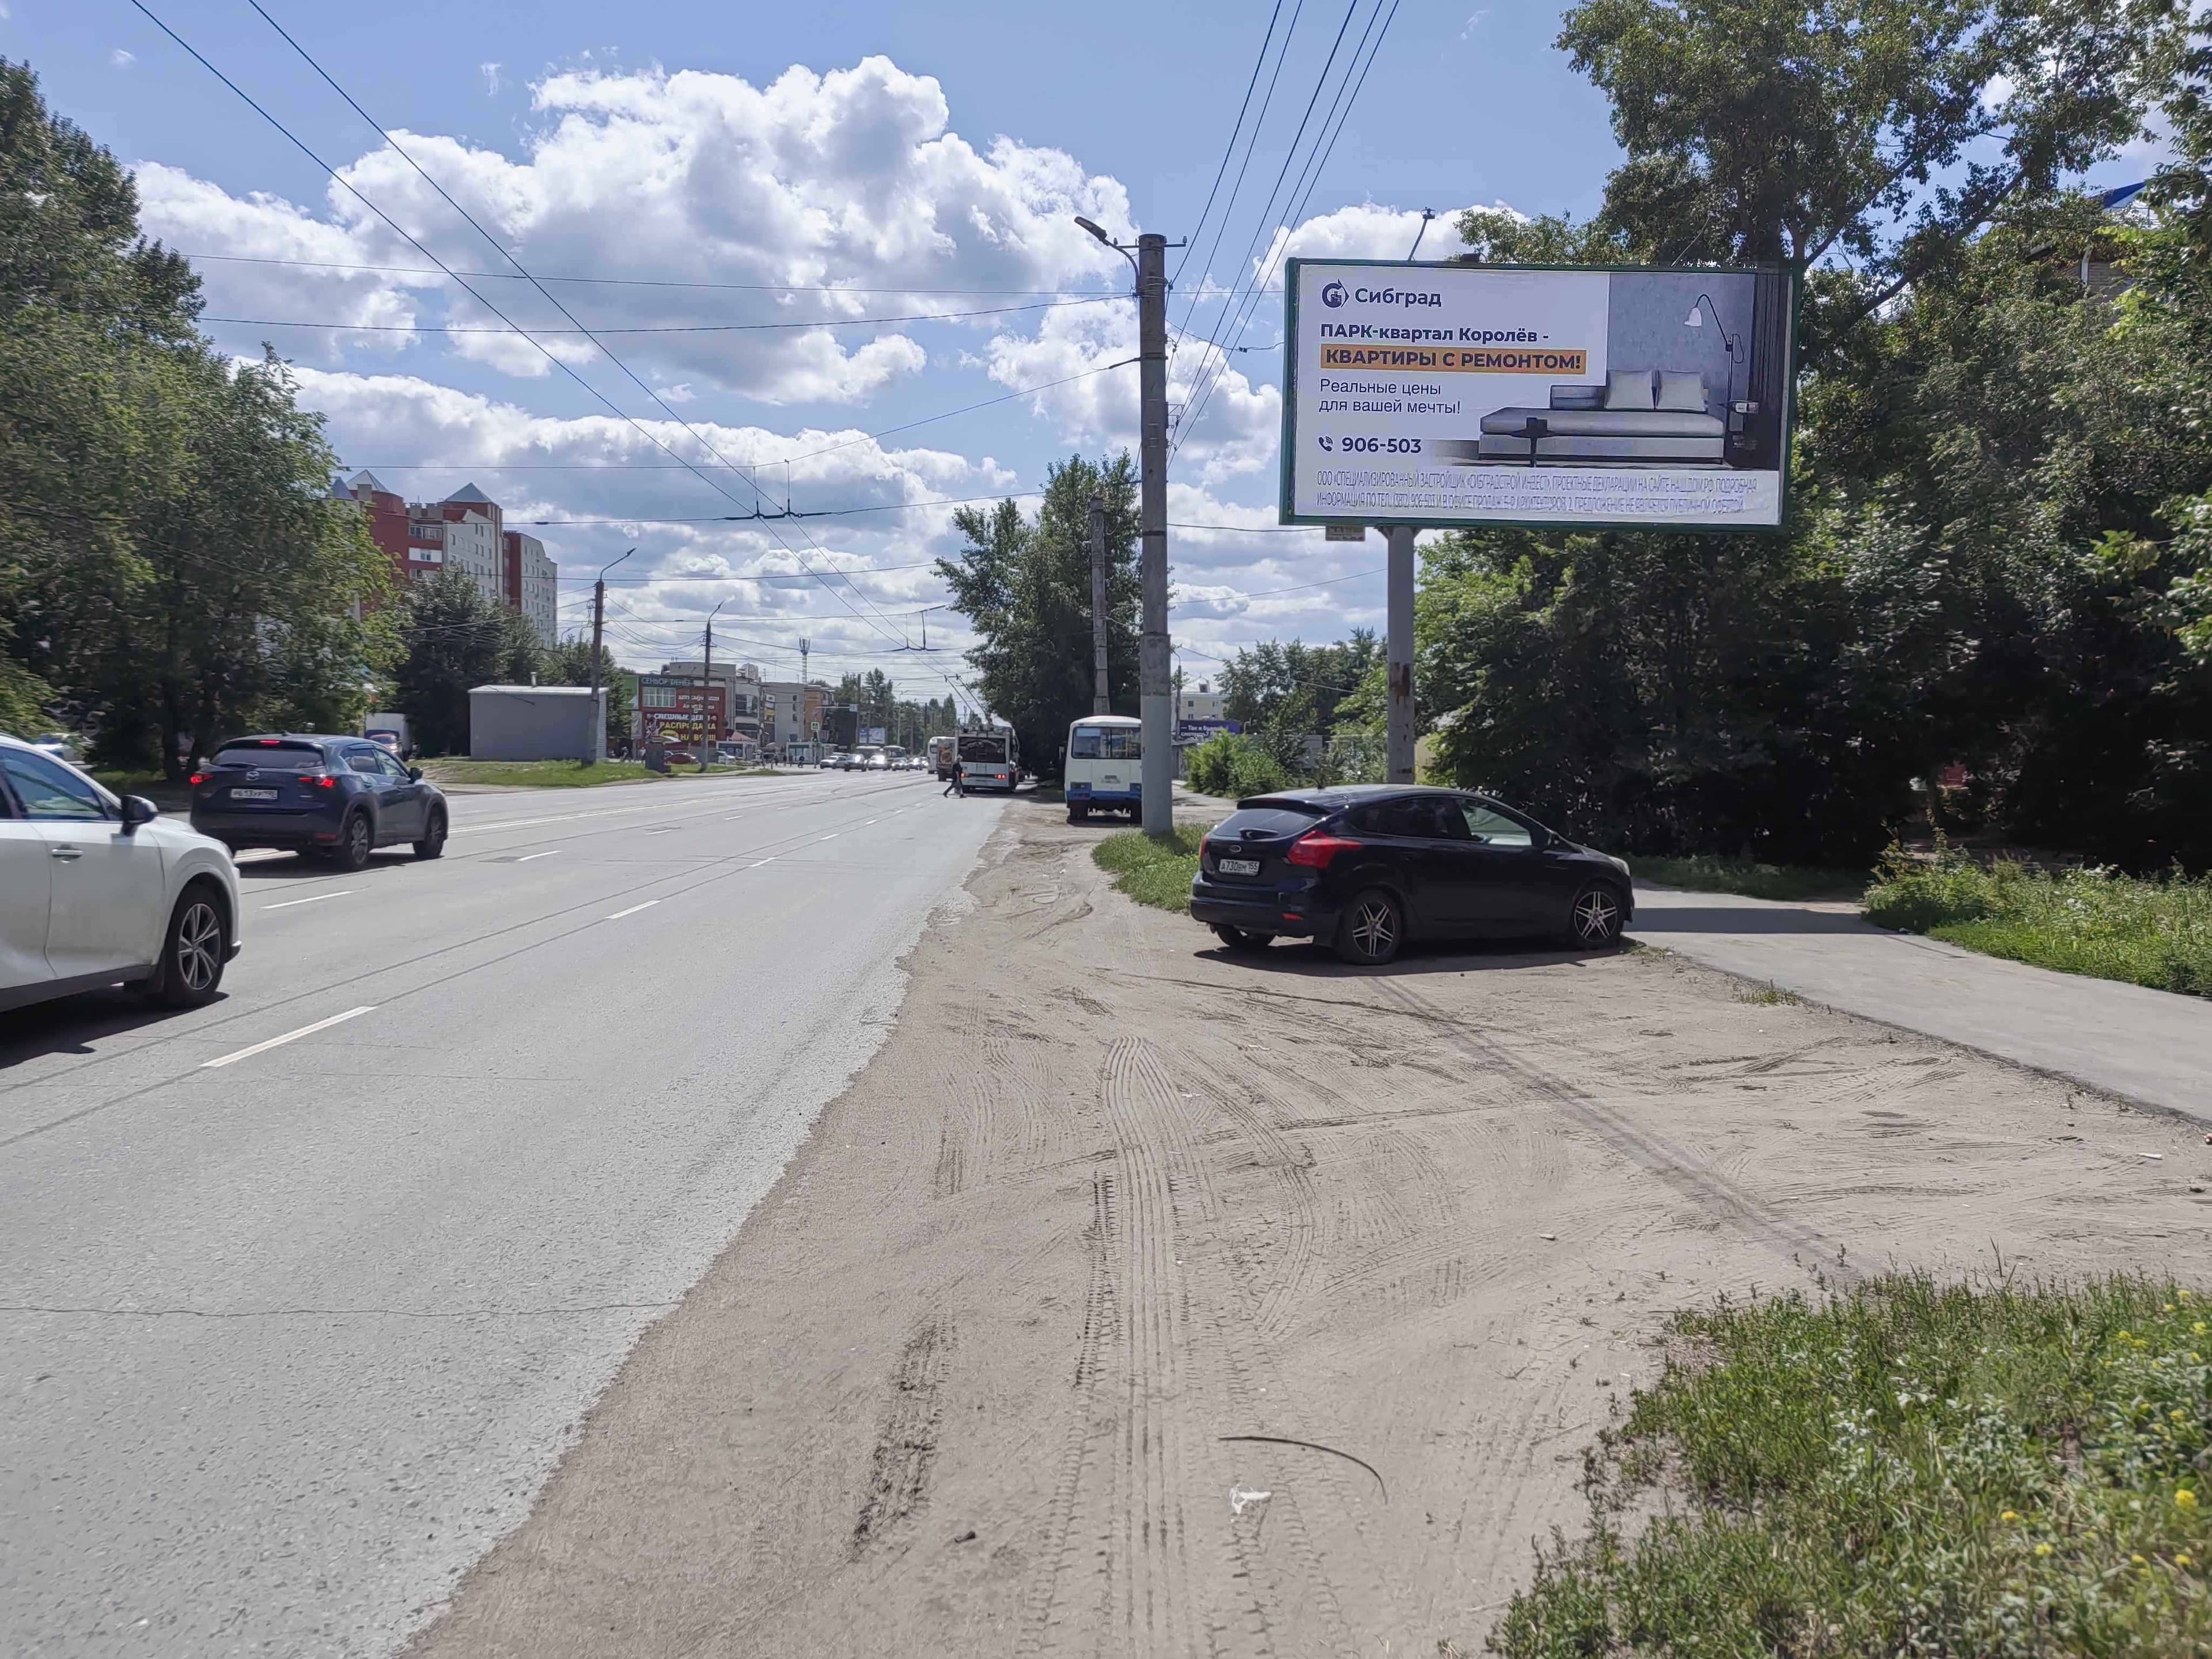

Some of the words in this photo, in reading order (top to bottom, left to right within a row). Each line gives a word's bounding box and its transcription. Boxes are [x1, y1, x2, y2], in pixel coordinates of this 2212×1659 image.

[1355, 287, 1442, 308] Сибград
[1321, 323, 1453, 343] ПАРК-квартал
[1459, 327, 1537, 344] Королёв
[1326, 349, 1436, 366] КВАРТИРЫ
[1442, 353, 1455, 366] С
[1461, 353, 1581, 369] РЕМОНТОМ!
[1320, 378, 1397, 394] Реальные
[1402, 384, 1441, 396] цены
[1319, 400, 1348, 413] для
[1353, 399, 1402, 412] вашей
[1407, 401, 1461, 414] мечты!
[1342, 437, 1422, 453] 906-503
[1317, 471, 1333, 486] ООО
